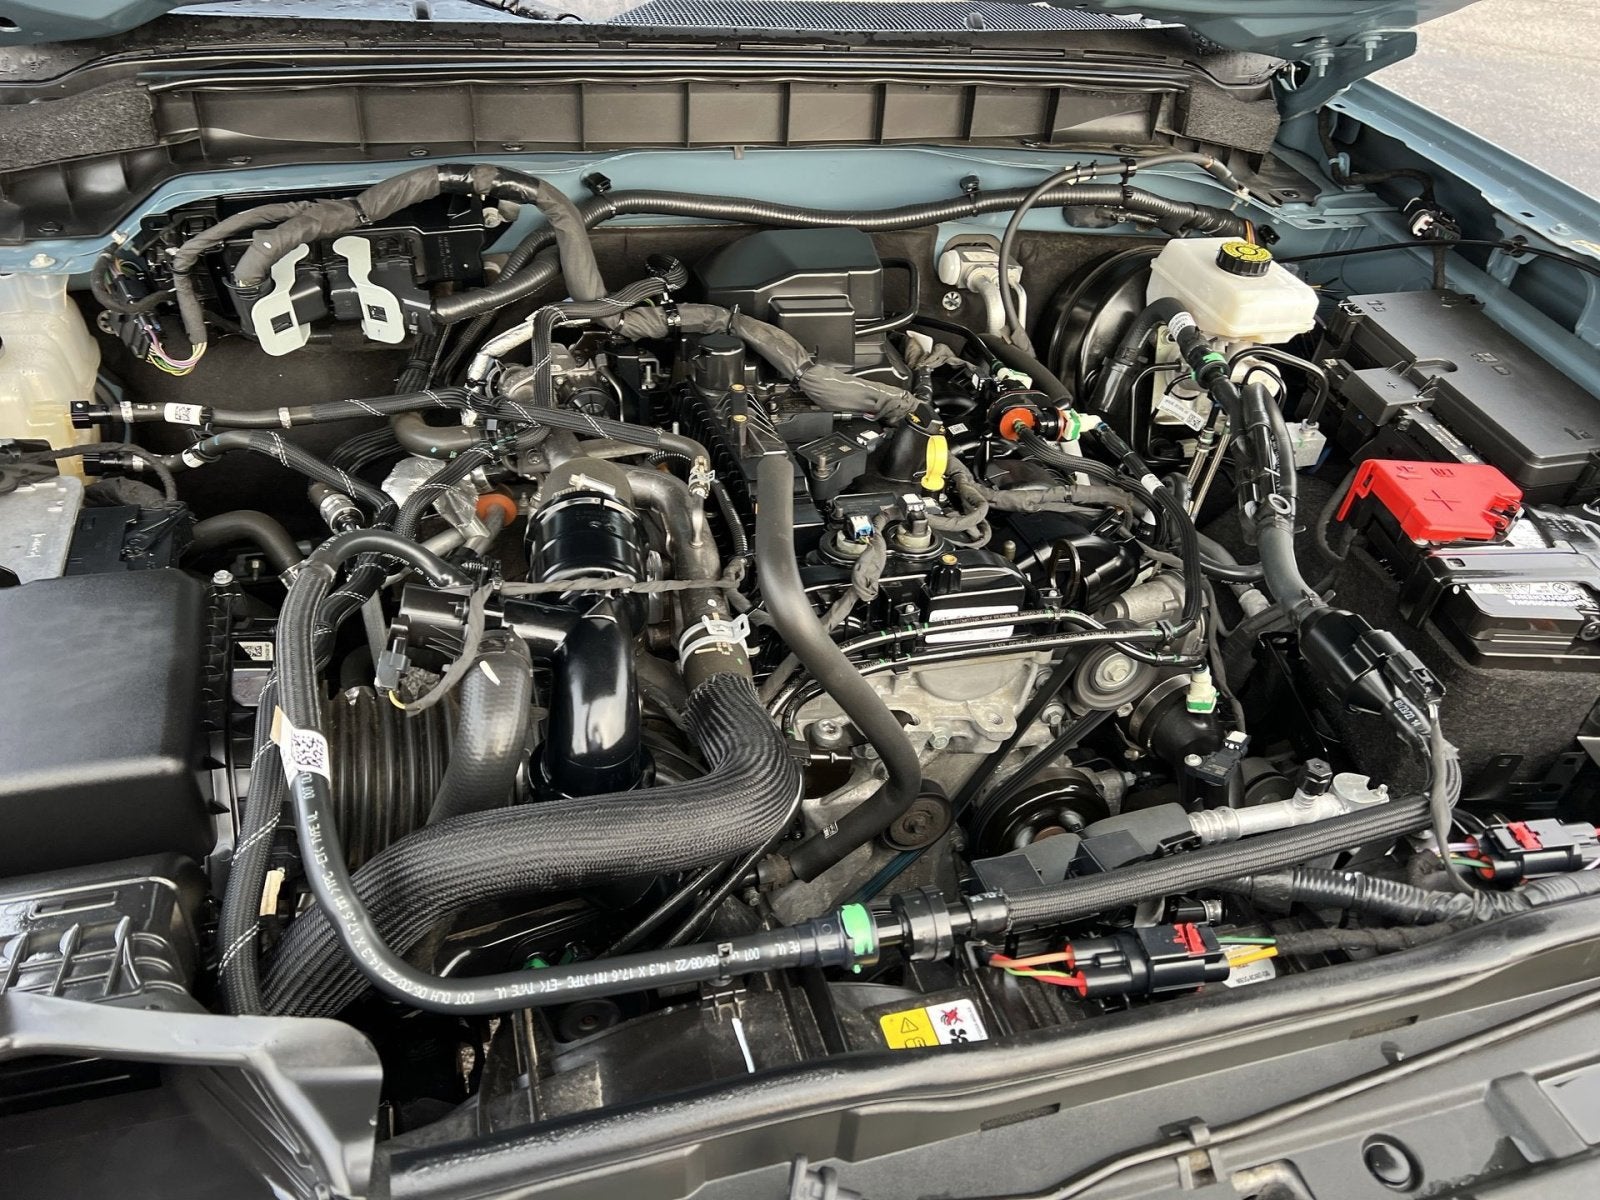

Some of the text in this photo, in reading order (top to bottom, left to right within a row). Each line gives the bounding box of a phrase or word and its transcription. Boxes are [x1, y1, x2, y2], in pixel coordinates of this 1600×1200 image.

[308, 823, 322, 845] TYPE
[342, 911, 361, 935] 17.6
[354, 937, 366, 948] X
[361, 947, 383, 970] 14.3
[744, 947, 760, 961] DOT
[611, 969, 634, 982] 17.6
[638, 966, 646, 977] X
[649, 961, 671, 976] 14.3
[510, 981, 536, 997] TYPE
[453, 991, 475, 1005] DOT
